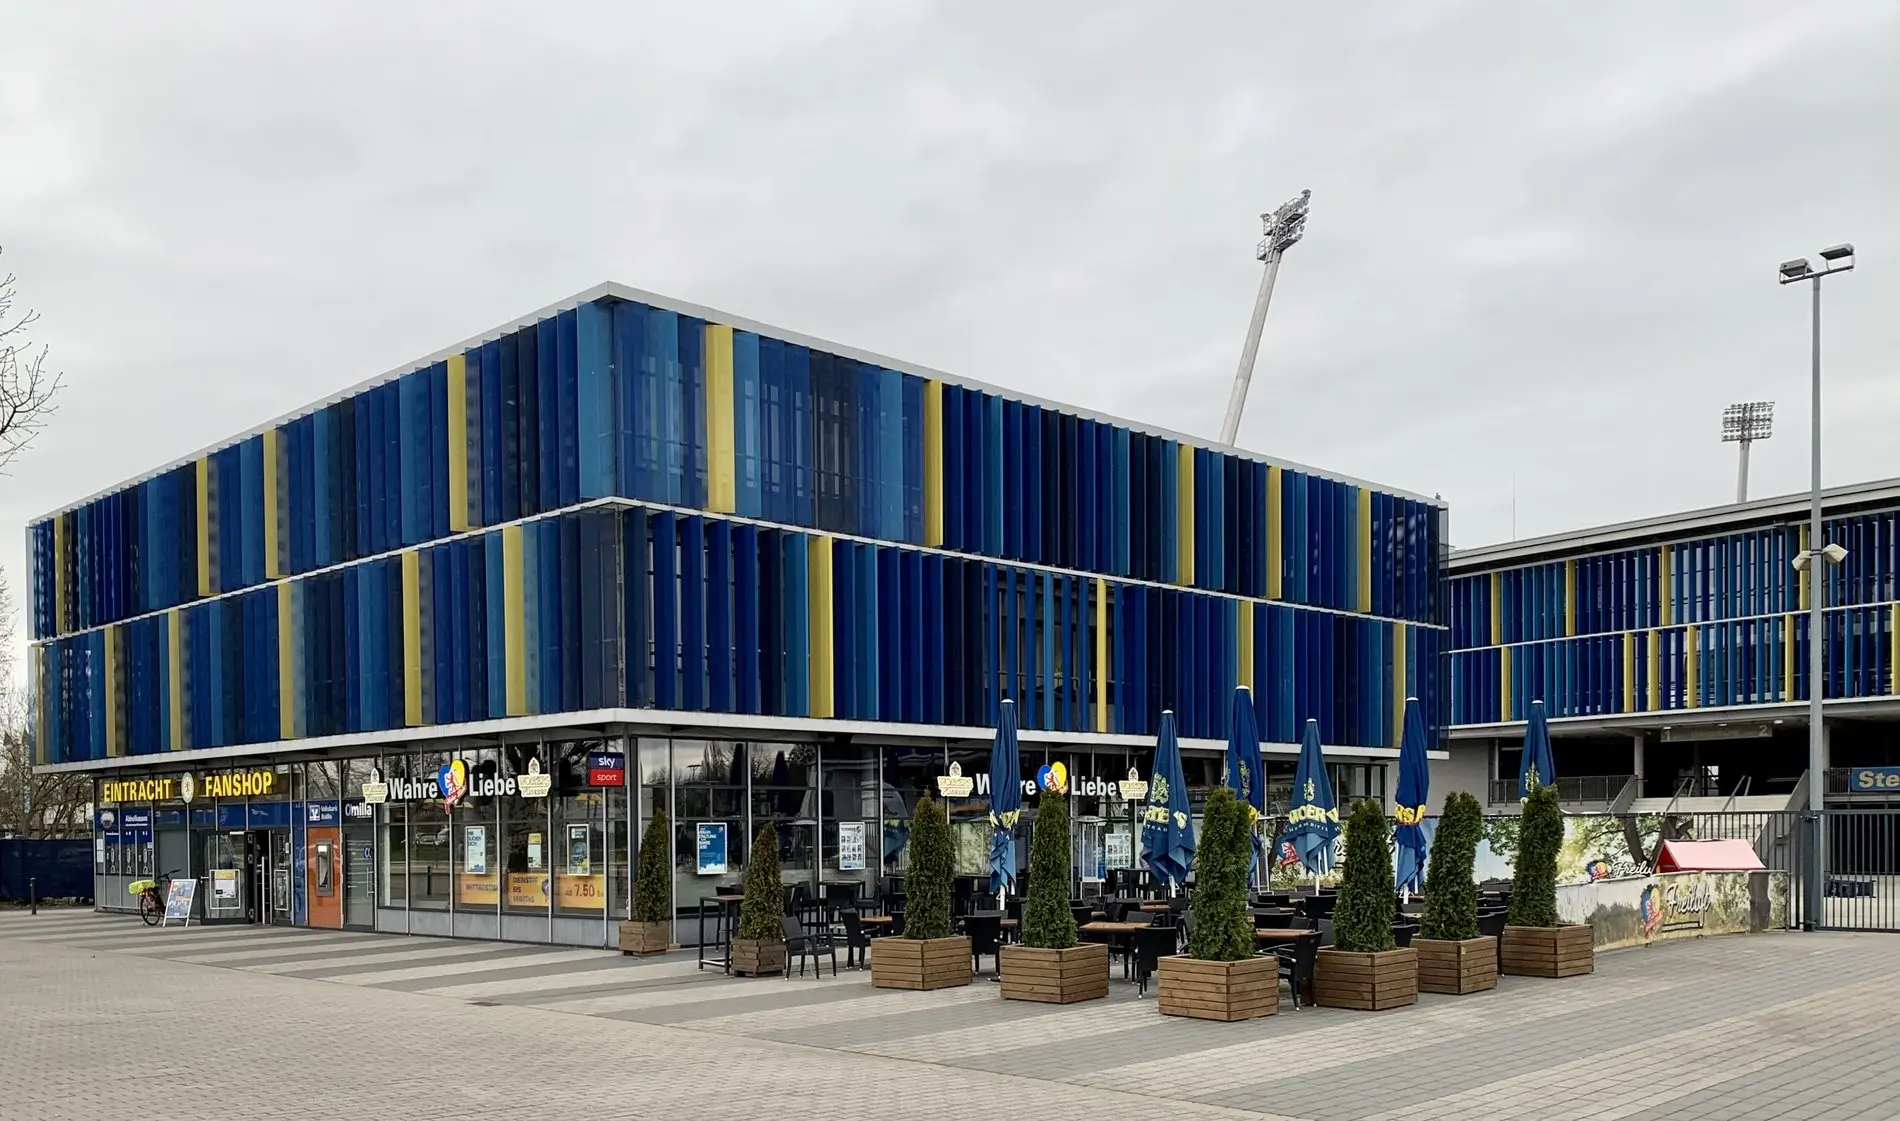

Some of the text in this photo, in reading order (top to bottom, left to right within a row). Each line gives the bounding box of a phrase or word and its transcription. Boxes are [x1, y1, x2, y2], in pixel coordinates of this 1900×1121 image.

[1759, 724, 1768, 736] 2
[598, 756, 615, 768] sky
[596, 774, 617, 782] sport
[975, 773, 1117, 796] Wre Liebe
[103, 771, 272, 802] EINTRACHT FANSHOP
[389, 777, 438, 800] Wahre
[469, 772, 516, 797] Liebe
[574, 883, 595, 897] 7.50
